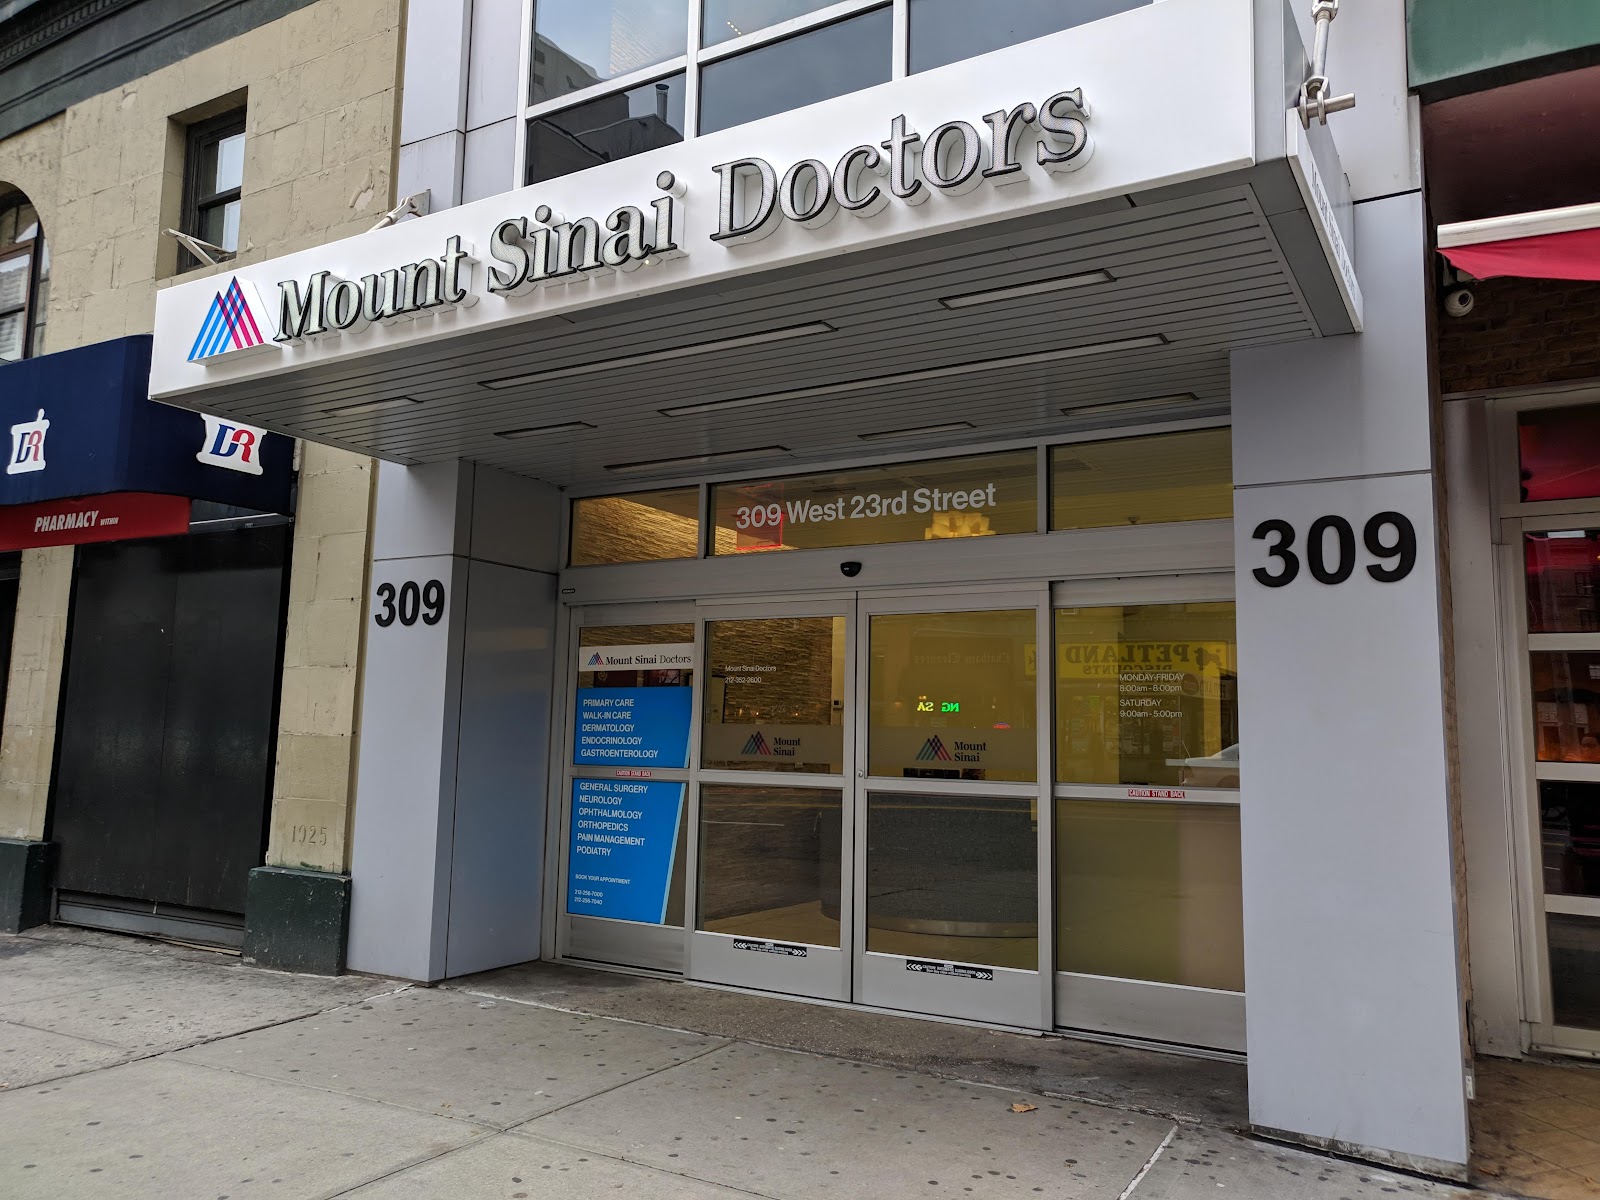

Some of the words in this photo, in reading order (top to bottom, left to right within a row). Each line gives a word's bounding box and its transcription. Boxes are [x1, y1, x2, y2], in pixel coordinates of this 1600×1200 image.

[273, 235, 467, 341] Mount
[487, 170, 678, 294] Sinai
[710, 87, 1089, 241] Doctors
[209, 424, 256, 464] DR
[735, 503, 782, 529] 309
[786, 498, 845, 524] West
[850, 490, 907, 519] 23rd
[912, 483, 996, 513] Street
[34, 510, 99, 533] PHARMACY
[100, 516, 119, 526] WITHIN
[1252, 511, 1417, 588] 309
[375, 579, 445, 627] 309
[605, 656, 633, 666] Mount
[635, 655, 657, 665] Sinai
[659, 655, 692, 664] Doctors
[1120, 673, 1184, 682] MONDAY-FRIDAY
[1153, 685, 1182, 693] 8:00pm
[583, 699, 614, 707] PRIMARY
[615, 699, 635, 707] CARE
[1120, 699, 1162, 707] SATURDAY
[583, 711, 612, 720] WALK-IN
[612, 711, 632, 720] CARE
[1153, 710, 1182, 719] 5:00pm
[582, 724, 635, 732] DERMATOLOGY
[581, 737, 642, 745] ENDOCRINOLOGY
[773, 737, 801, 747] Mount
[954, 741, 986, 751] Mount
[581, 749, 658, 758] GASTROENTEROLOGY
[773, 747, 795, 756] Sinai
[954, 752, 980, 762] Sinai
[580, 782, 613, 792] GENERAL
[614, 784, 648, 793] SURGERY
[1130, 789, 1150, 797] CAUTION
[1170, 790, 1184, 798] BACK
[579, 795, 622, 805] NEUROLOGY
[578, 808, 642, 819] OPHTHALMOLOGY
[578, 820, 629, 832] ORTHOPEDICS
[292, 825, 327, 846] 1925
[577, 833, 593, 842] PAIN
[593, 835, 645, 846] MANAGEMENT
[576, 846, 611, 856] PODIATRY
[600, 876, 630, 884] APPOINTMENT
